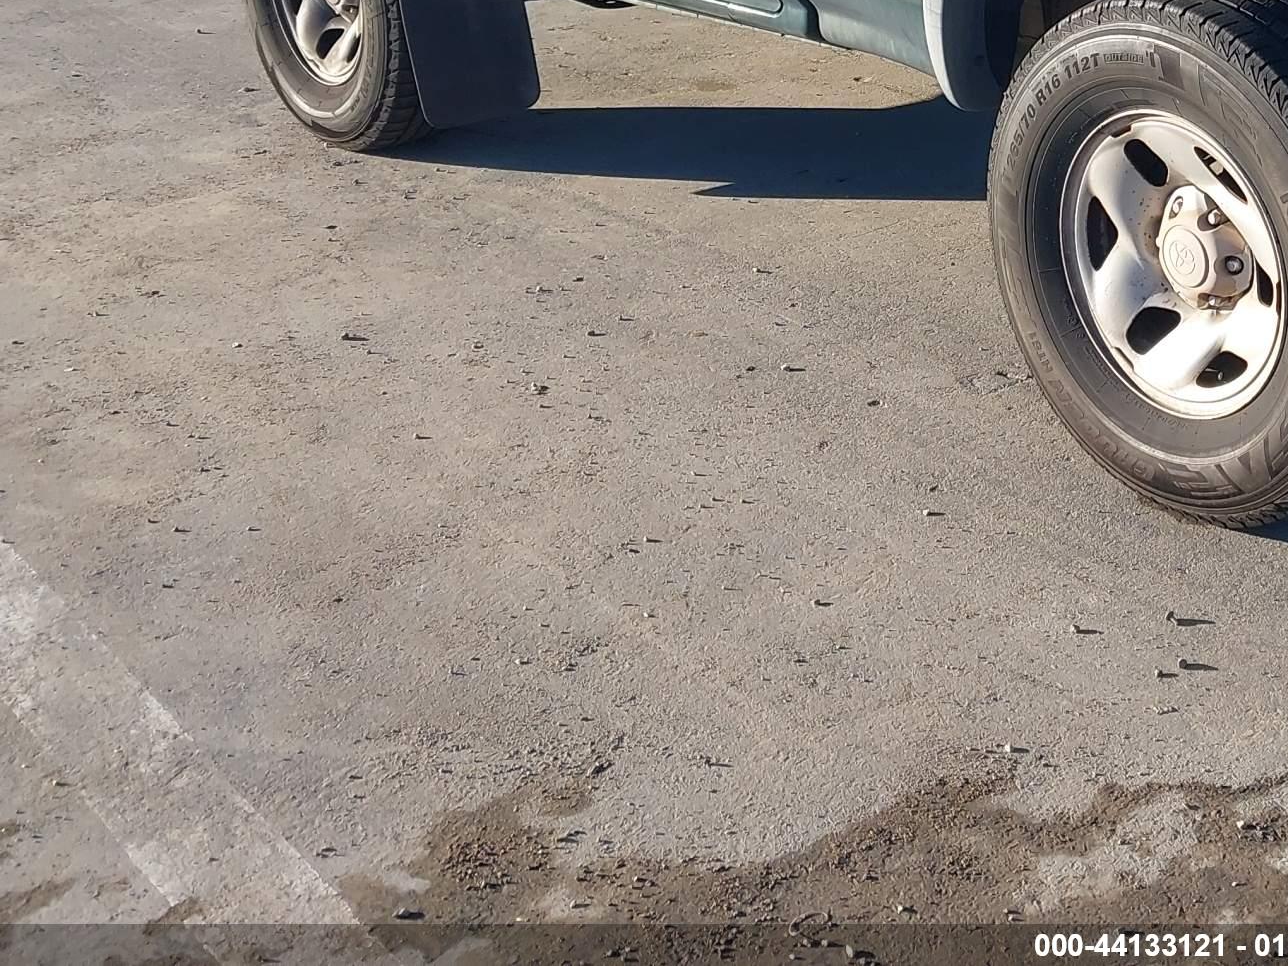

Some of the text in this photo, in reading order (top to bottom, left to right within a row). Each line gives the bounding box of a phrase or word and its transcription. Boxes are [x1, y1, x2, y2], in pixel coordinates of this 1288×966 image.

[1006, 103, 1037, 168] 265/70
[1035, 75, 1061, 107] R16
[1064, 52, 1100, 80] 112T
